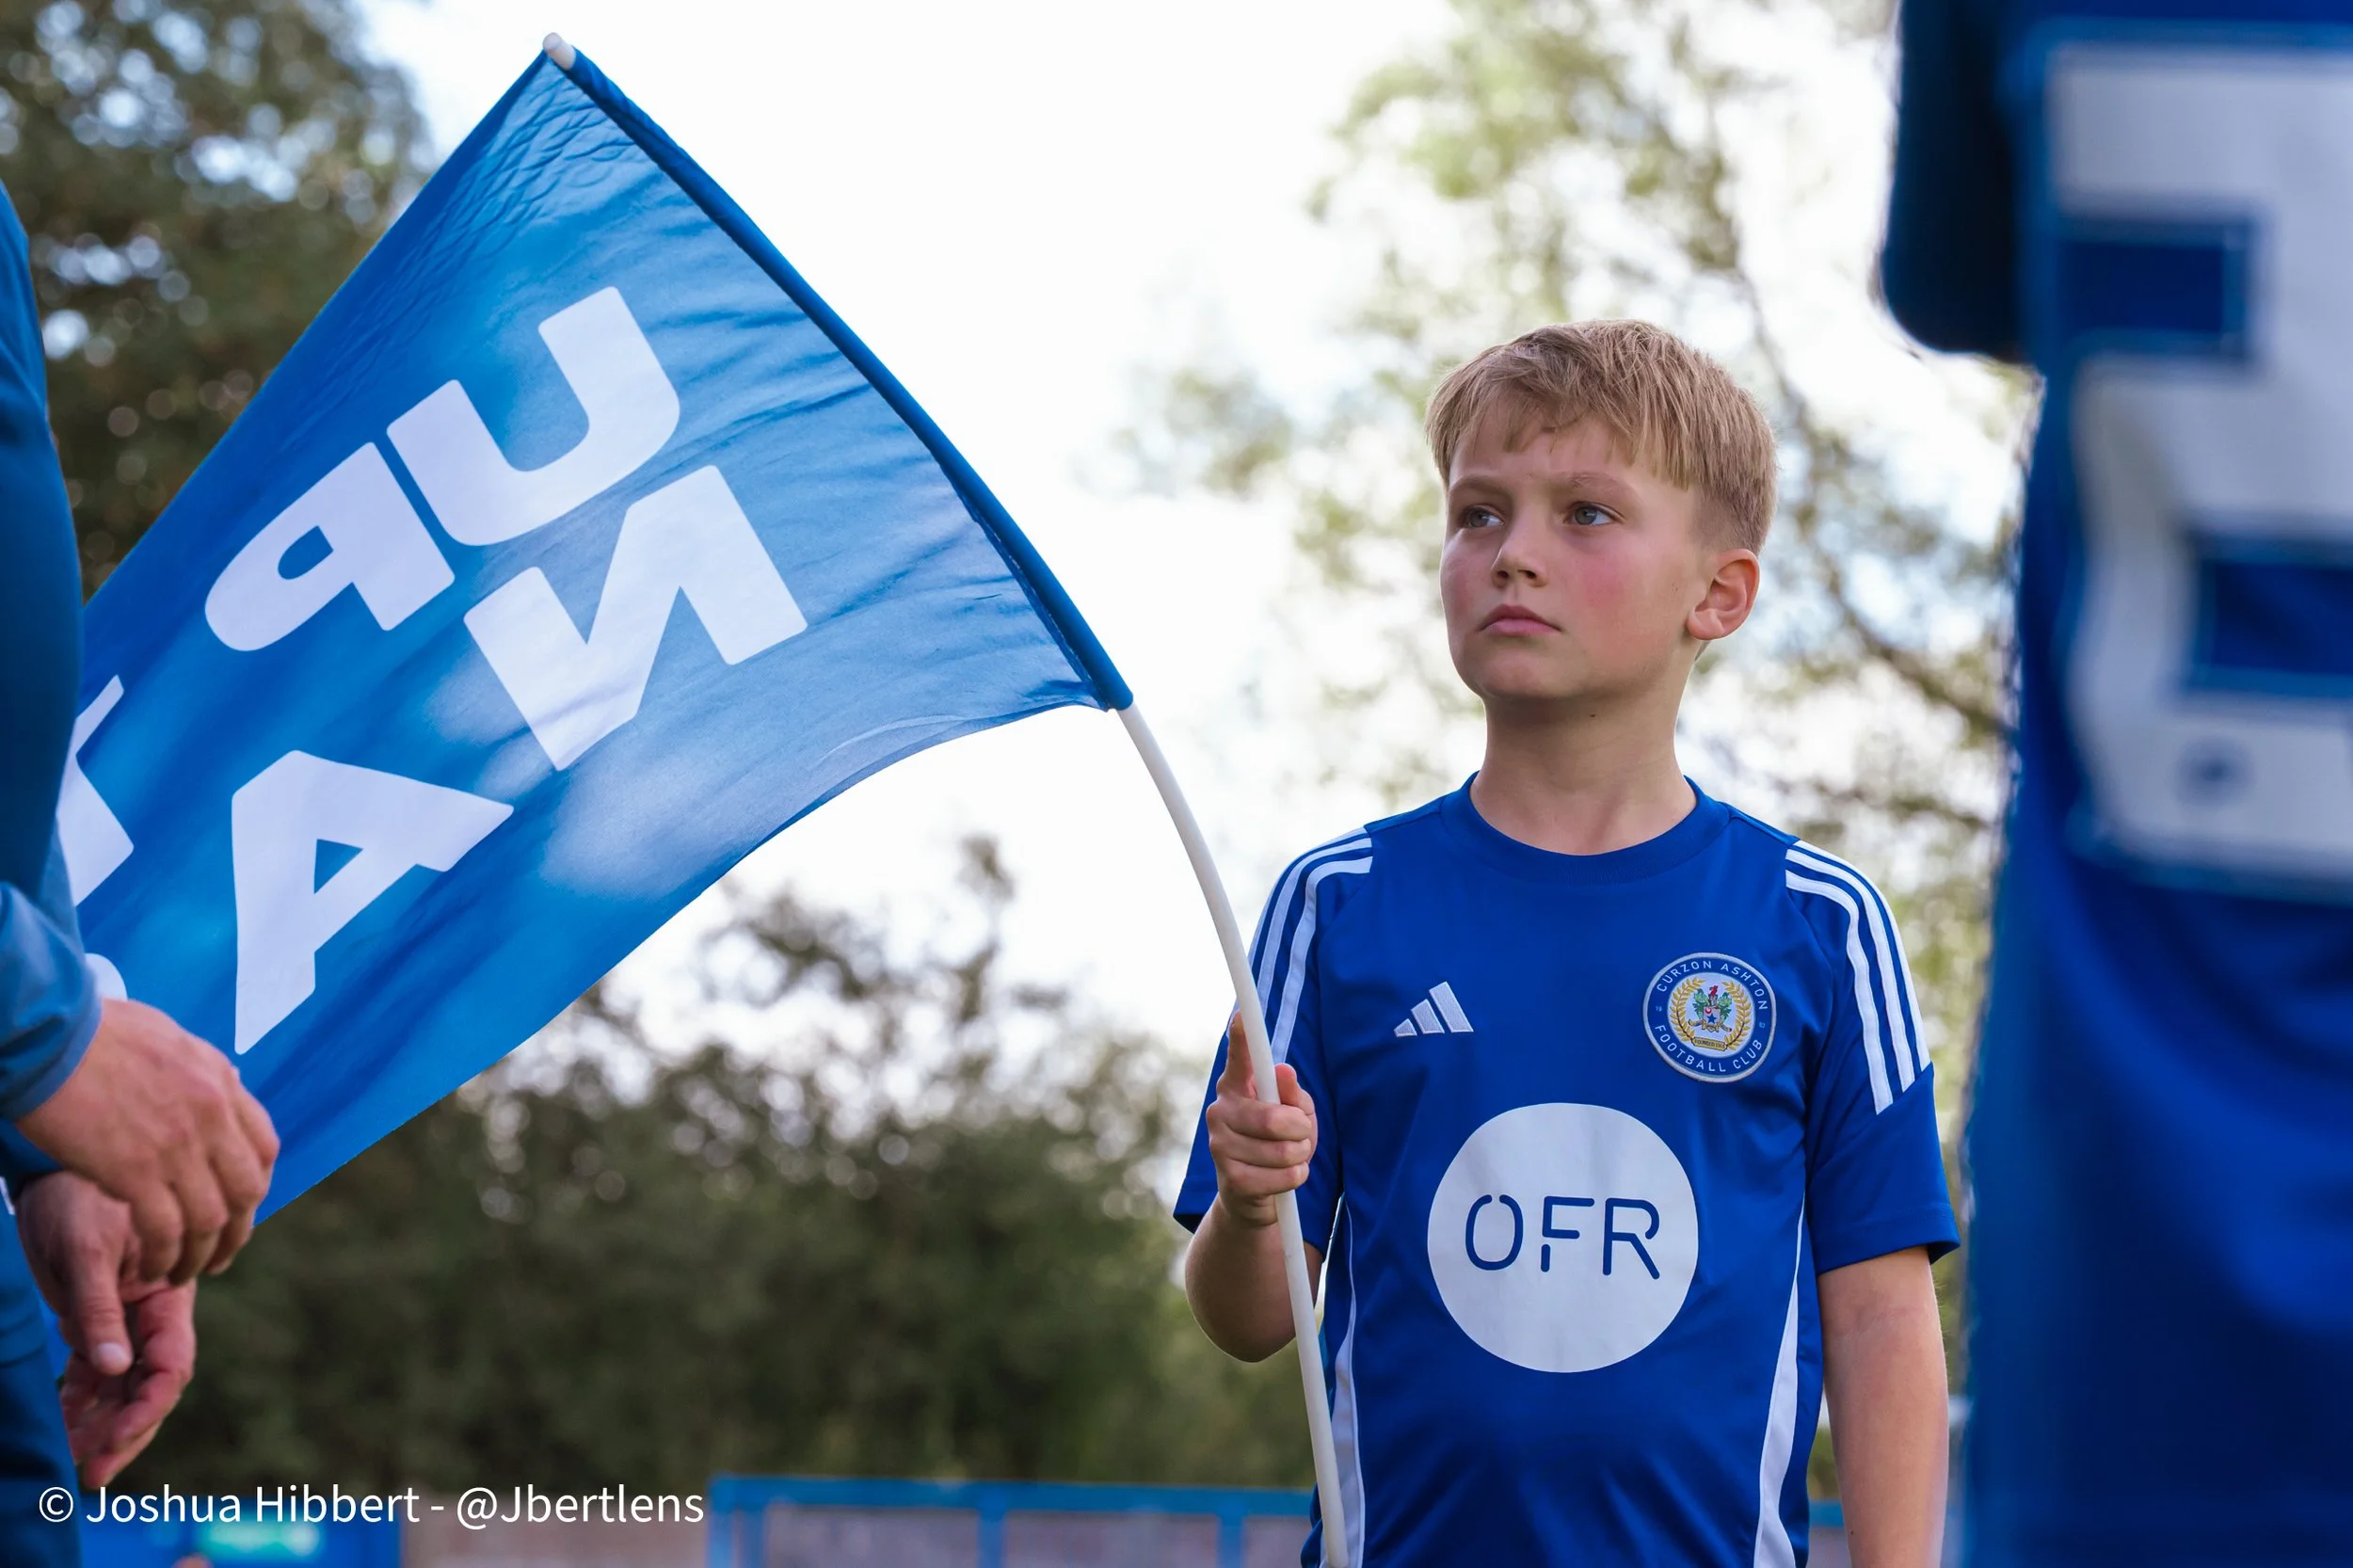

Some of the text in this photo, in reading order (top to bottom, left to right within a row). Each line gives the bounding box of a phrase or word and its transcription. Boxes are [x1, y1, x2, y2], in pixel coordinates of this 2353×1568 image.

[1656, 960, 1769, 1011] CURZON ASHTON
[1654, 1024, 1763, 1073] FOOTBALL CLUB
[1465, 1193, 1660, 1280] OFR
